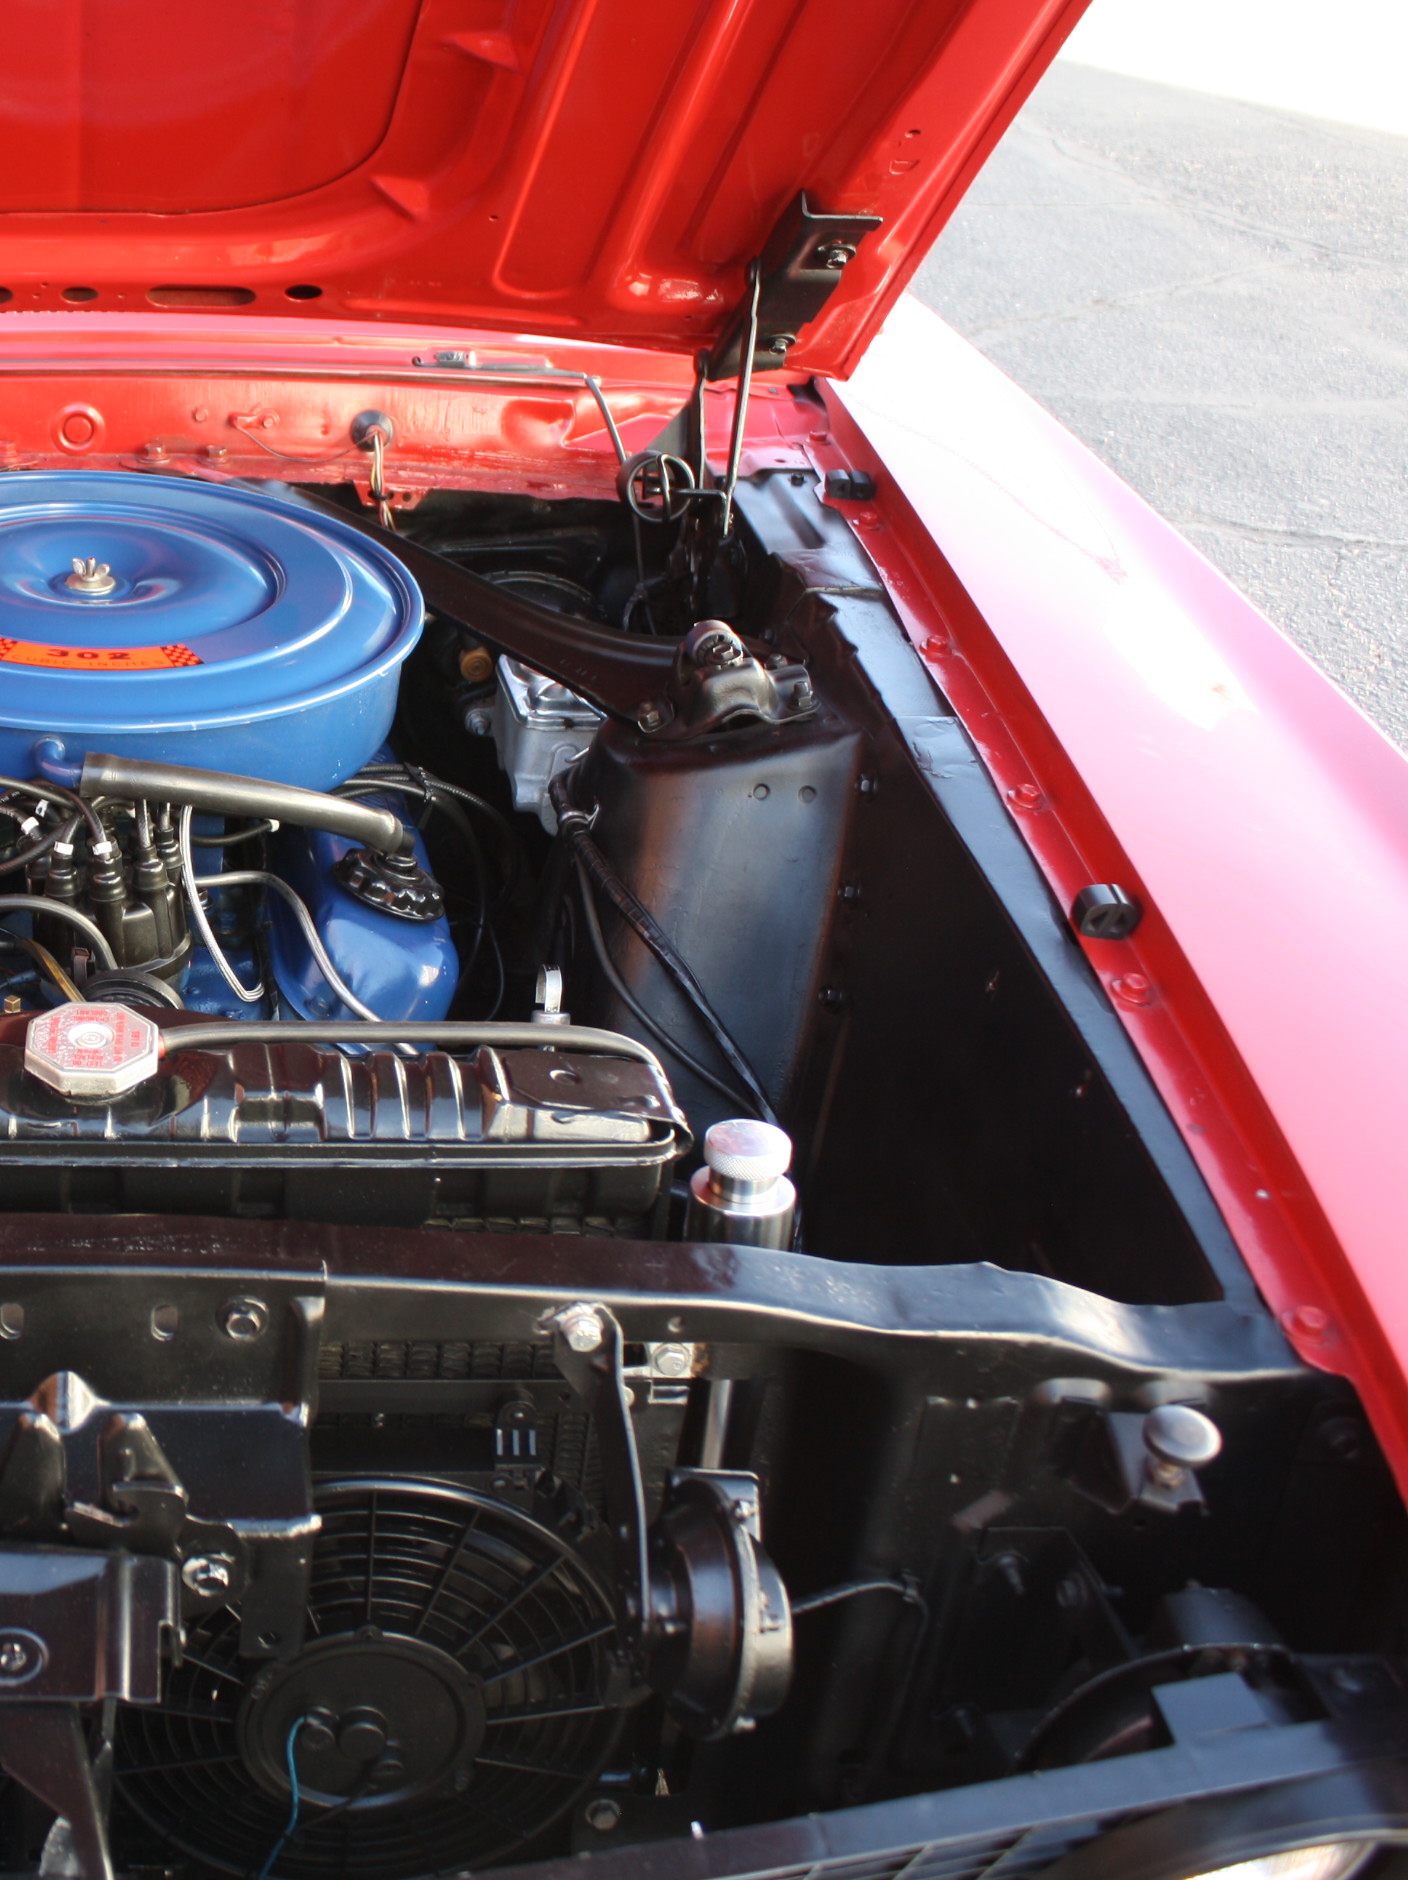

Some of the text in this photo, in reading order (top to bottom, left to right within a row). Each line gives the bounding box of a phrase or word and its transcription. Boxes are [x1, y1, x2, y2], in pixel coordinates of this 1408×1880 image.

[11, 654, 165, 668] CUBIC INCHES
[46, 648, 131, 661] 302
